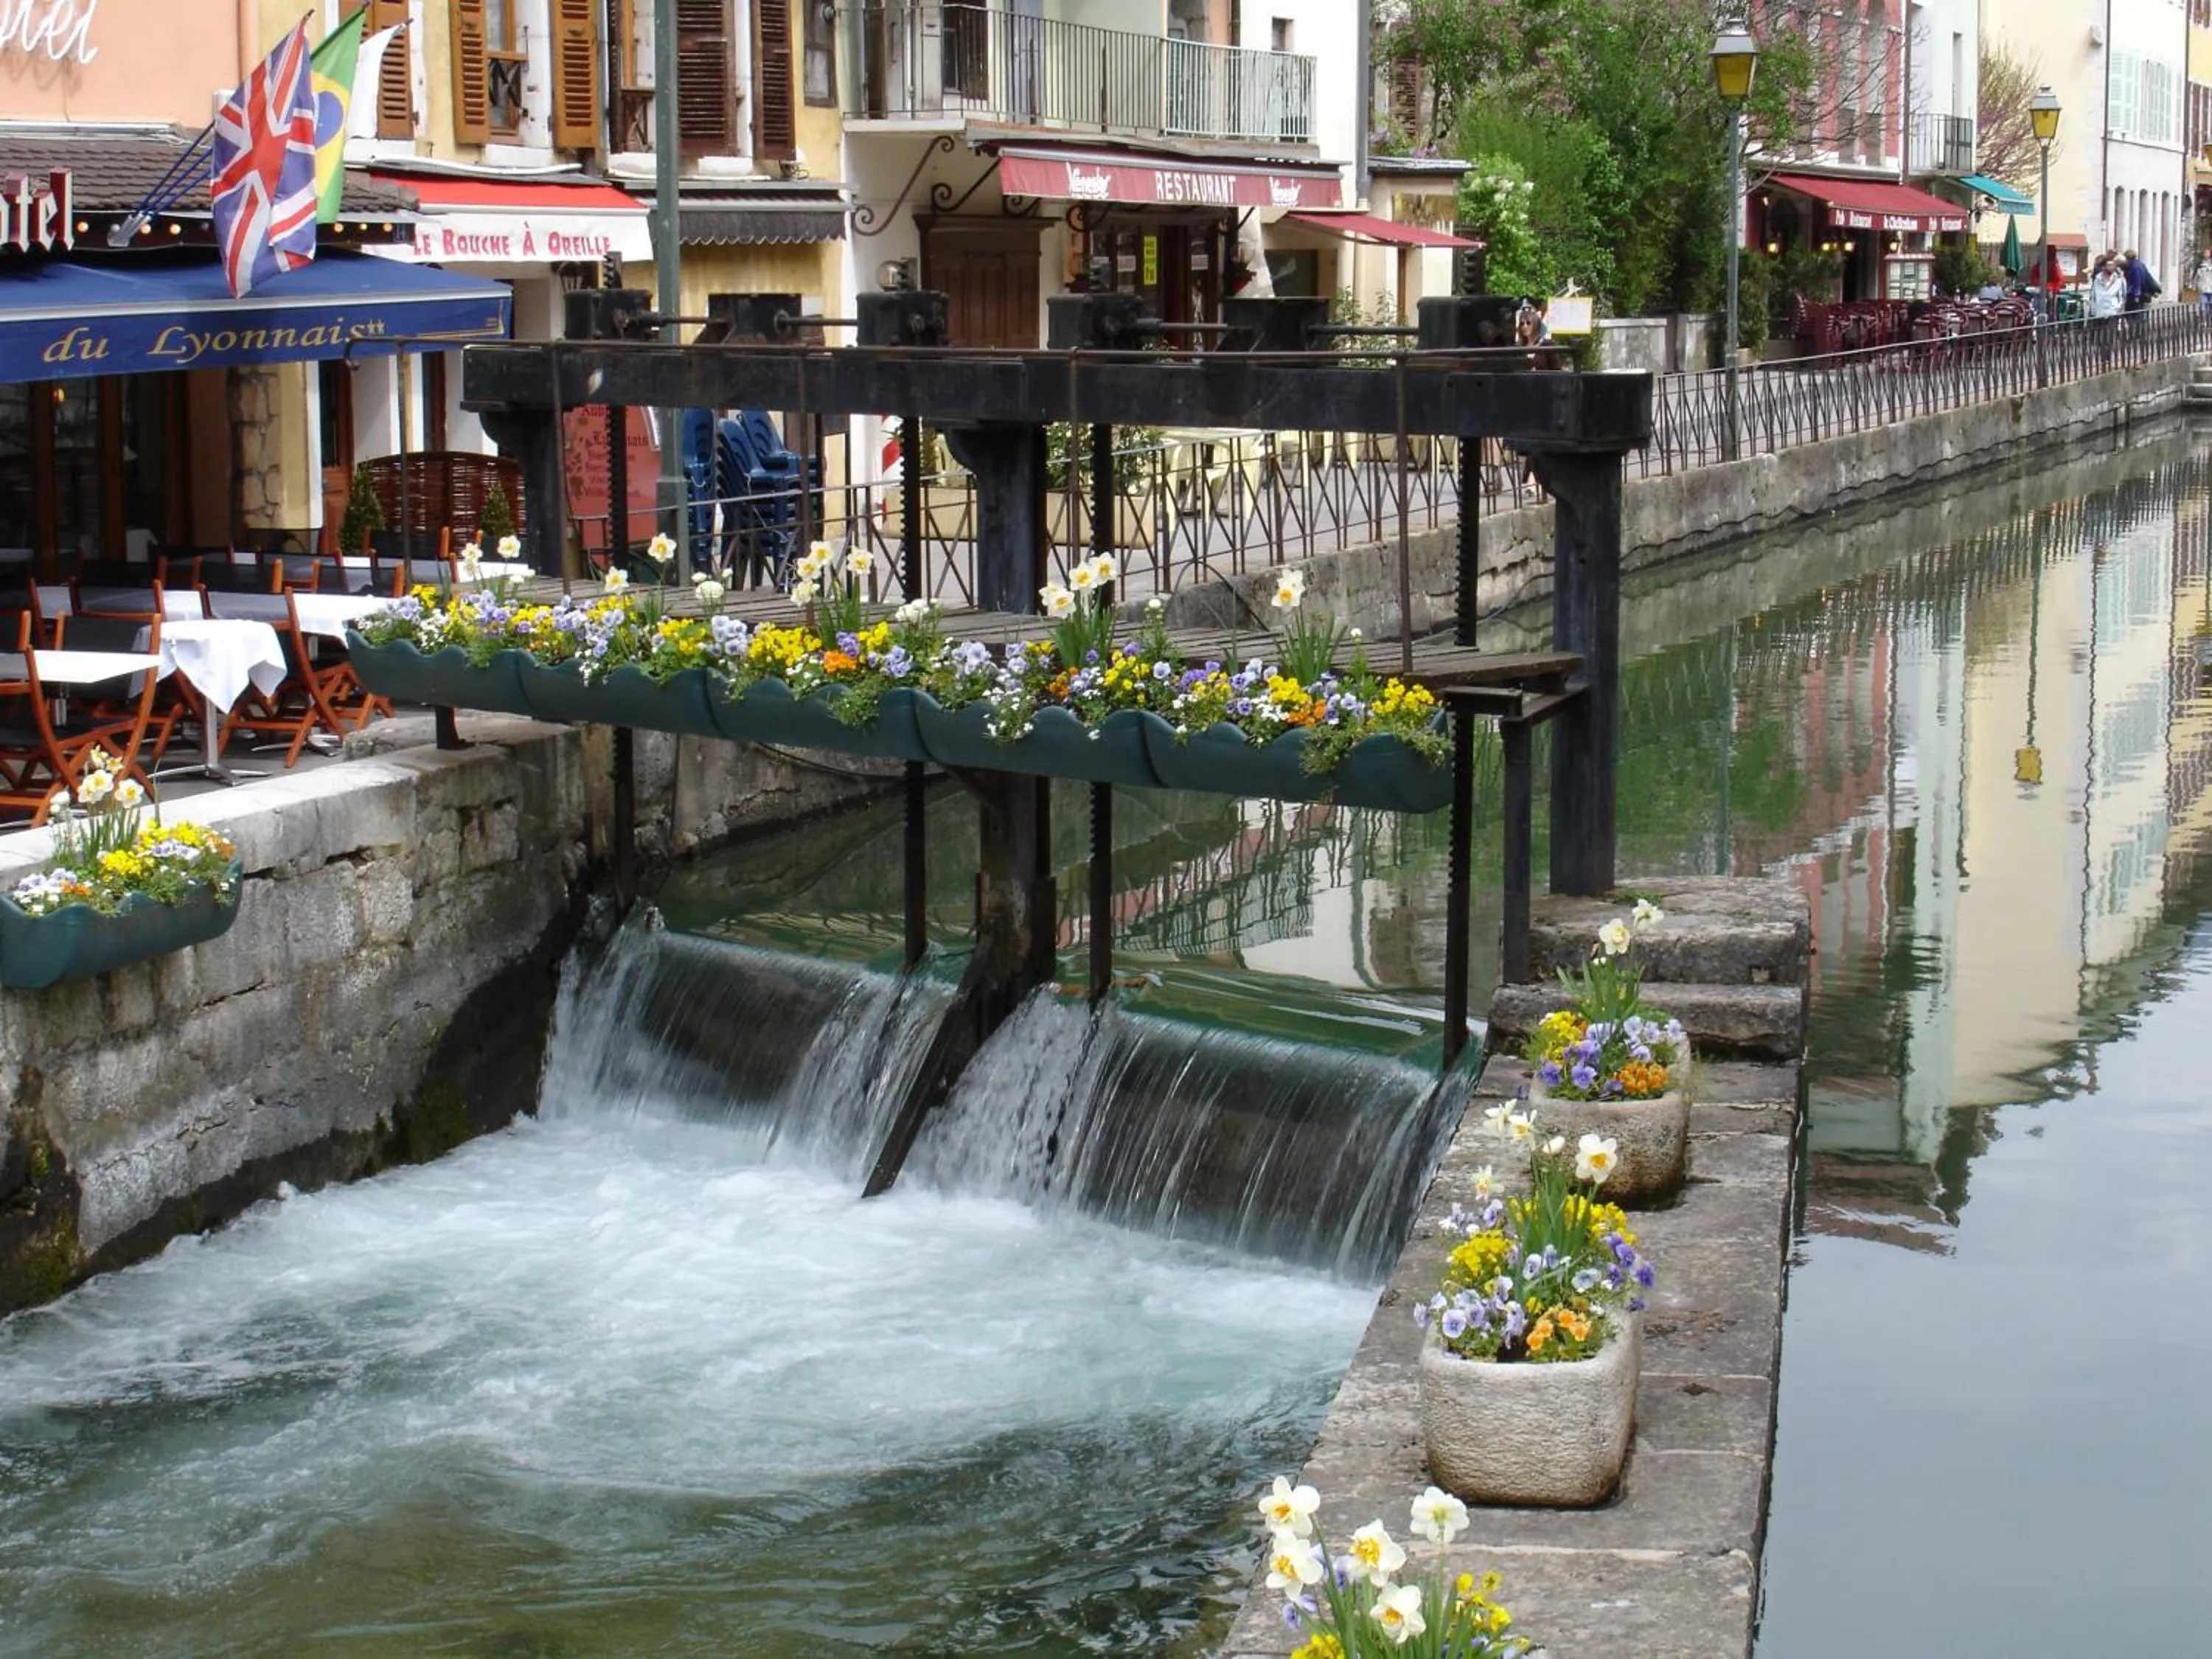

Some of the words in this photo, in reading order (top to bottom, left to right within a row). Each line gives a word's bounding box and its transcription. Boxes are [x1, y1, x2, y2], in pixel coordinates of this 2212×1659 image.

[1155, 171, 1237, 204] RESTAURANT
[523, 220, 536, 256] À
[43, 327, 109, 363] du
[147, 317, 366, 364] Lyonnais
